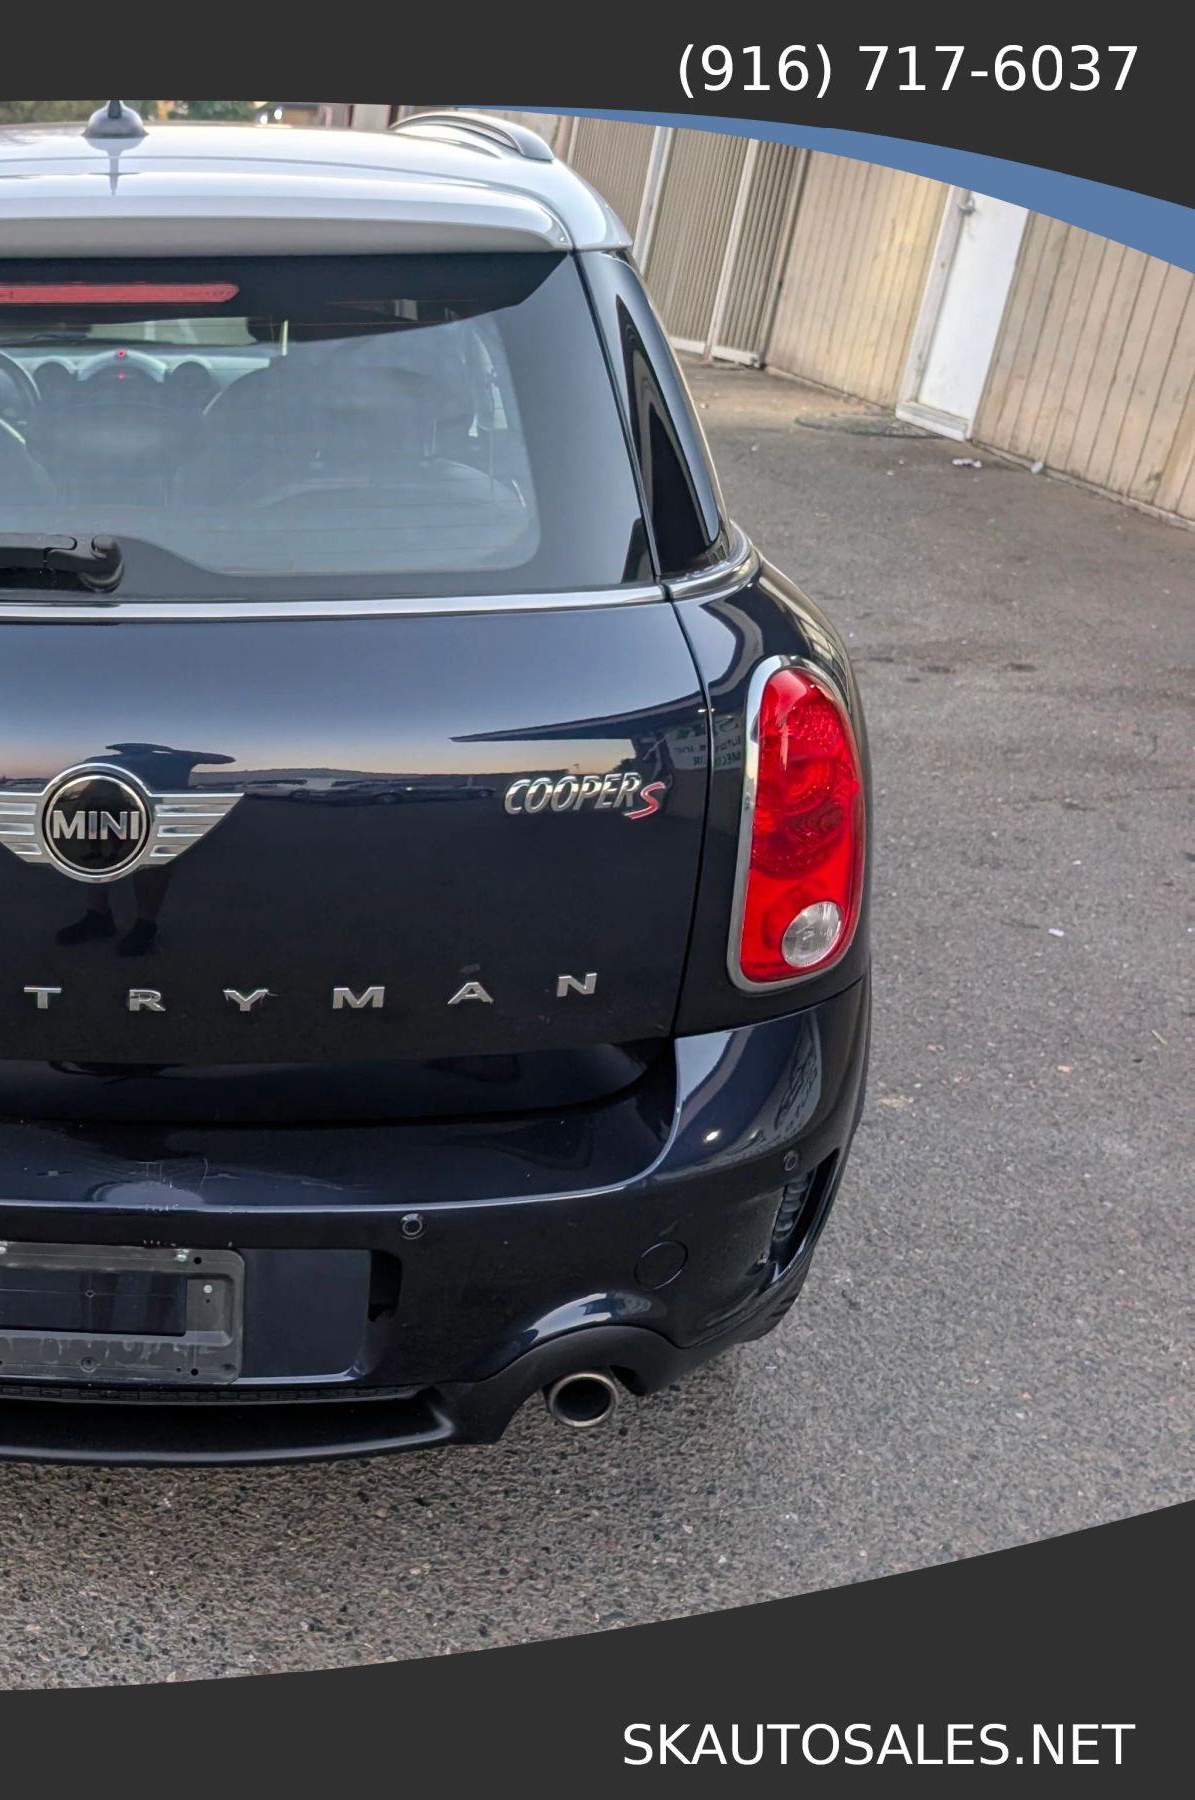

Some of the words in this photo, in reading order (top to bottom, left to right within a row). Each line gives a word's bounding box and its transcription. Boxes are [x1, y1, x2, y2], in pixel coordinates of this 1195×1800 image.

[505, 772, 642, 815] COOPER
[623, 781, 666, 820] S
[52, 811, 140, 840] MINI
